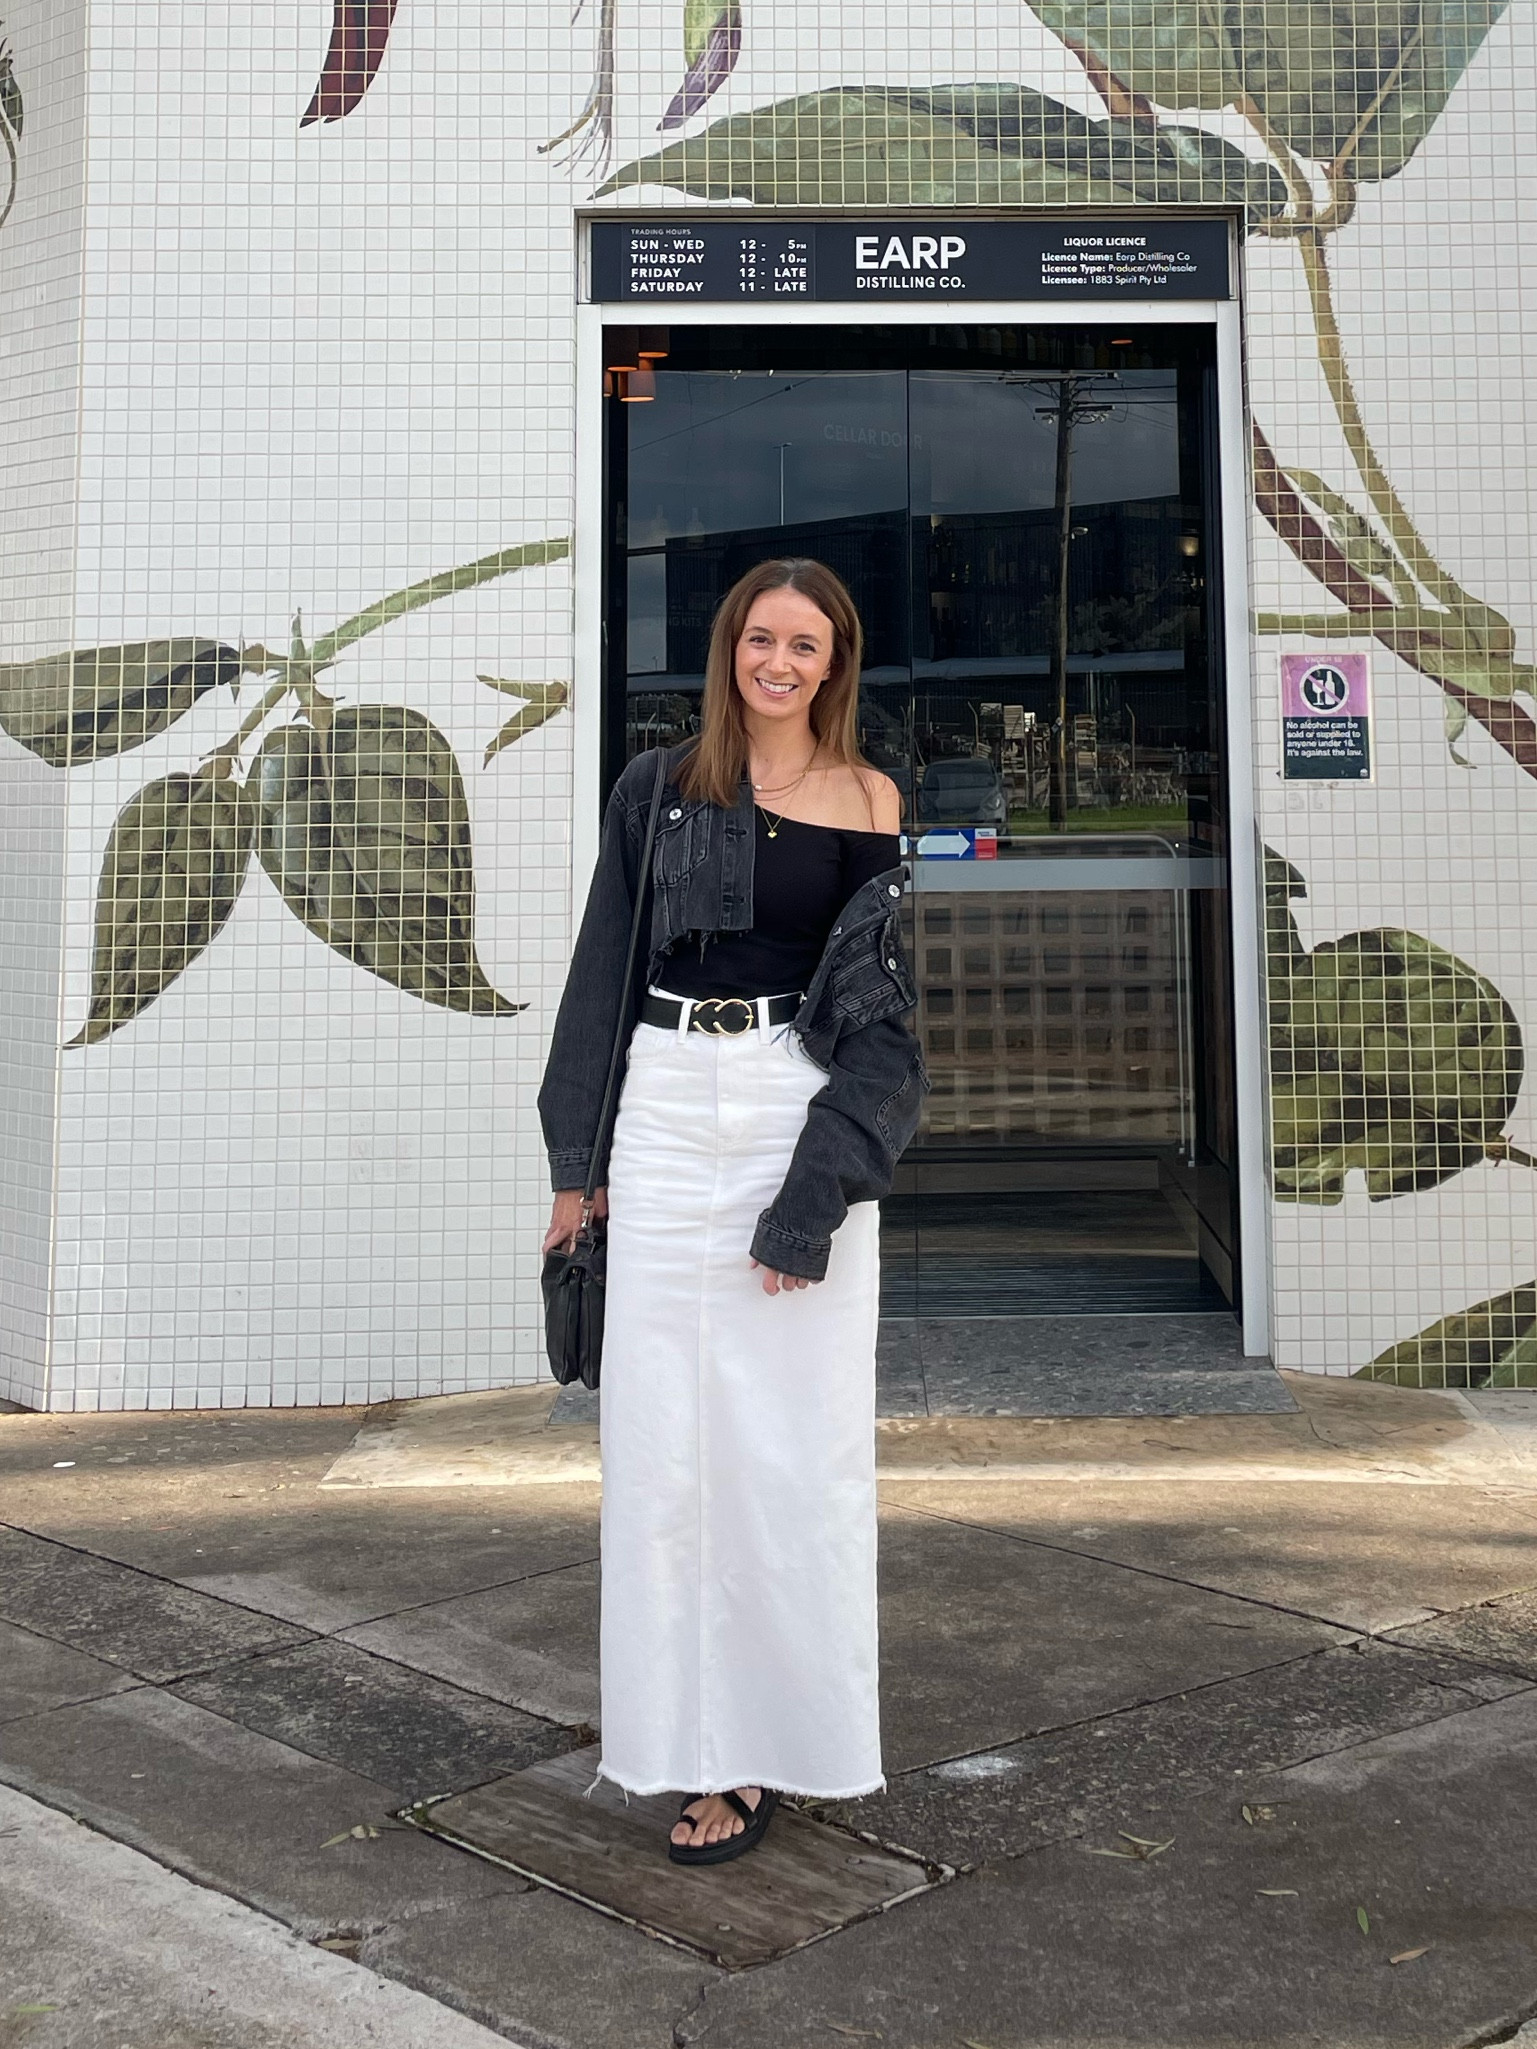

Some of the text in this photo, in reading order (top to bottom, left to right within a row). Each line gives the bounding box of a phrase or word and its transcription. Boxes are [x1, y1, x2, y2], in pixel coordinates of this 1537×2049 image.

[630, 240, 659, 250] SUN
[672, 240, 705, 250] WED
[740, 240, 756, 250] 12
[1064, 237, 1146, 246] LIQUOR LICENCE
[855, 236, 966, 269] EARP
[1041, 252, 1190, 262] Licence Name: Earp Distilling Co
[630, 254, 705, 264] THURSDAY
[740, 254, 756, 264] 12
[631, 268, 681, 278] FRIDAY
[740, 268, 756, 278] 12
[774, 268, 807, 278] LATE
[1041, 263, 1198, 274] Licence Type: Producer/Wholesaler
[856, 276, 966, 289] DISTILLING CO.
[1041, 275, 1167, 285] Licensee: 1883 Spirit Pty Ltd
[630, 282, 704, 292] SATURDAY
[739, 282, 755, 292] 11
[774, 282, 807, 292] LATE
[823, 424, 922, 450] CELLAR DOR
[1287, 721, 1298, 729] No
[1300, 721, 1329, 729] alcohol
[1348, 721, 1358, 729] be
[1287, 730, 1304, 738] sold
[1316, 730, 1350, 740] supplied
[1352, 730, 1360, 738] to
[1287, 741, 1316, 749] anyone
[1301, 749, 1330, 758] against
